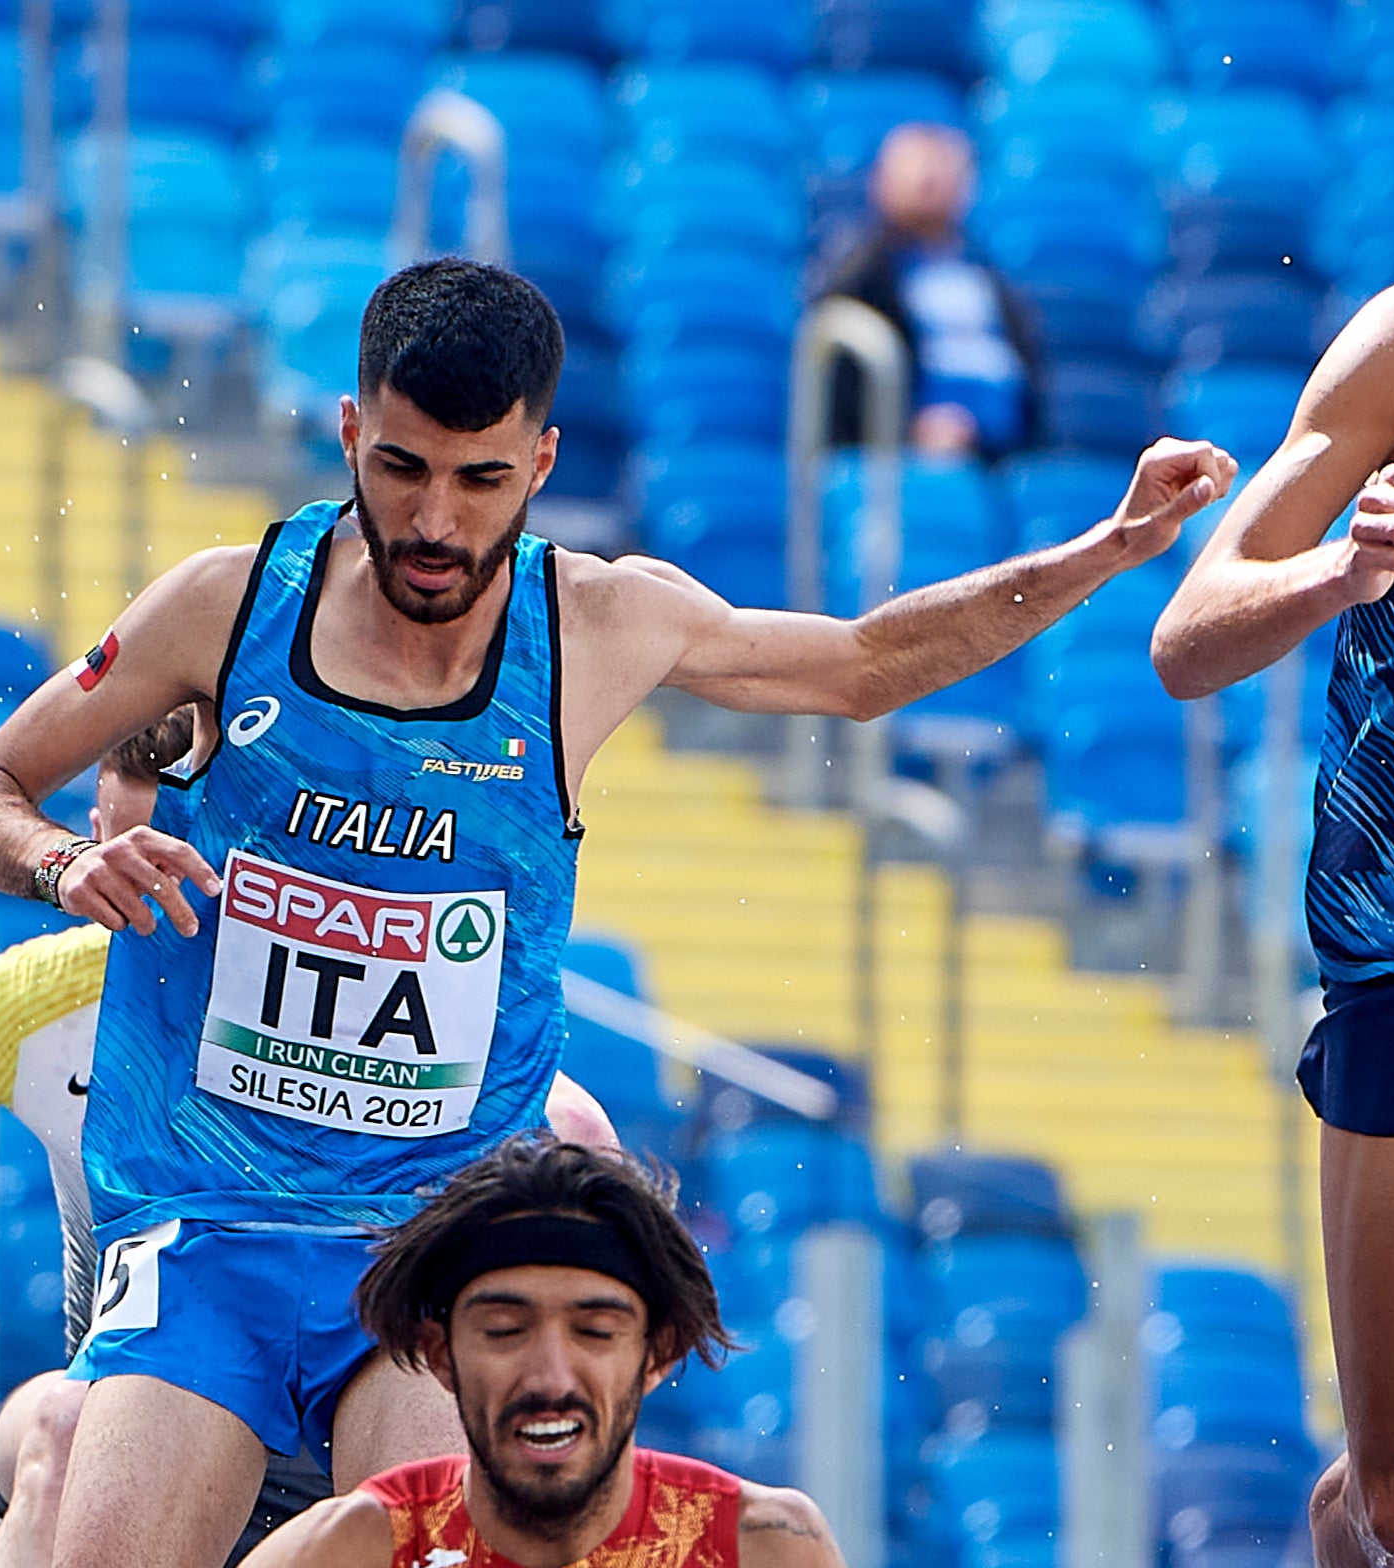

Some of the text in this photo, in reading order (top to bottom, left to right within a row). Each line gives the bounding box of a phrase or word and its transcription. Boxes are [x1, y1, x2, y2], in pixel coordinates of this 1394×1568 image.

[421, 758, 525, 782] FASTWEB
[287, 791, 454, 861] ITALIA
[232, 868, 423, 955] SPAR
[259, 941, 437, 1056] ITA
[255, 1036, 265, 1058] I
[267, 1040, 325, 1070] RUN
[229, 1064, 443, 1127] SILESIA 2021
[99, 1241, 146, 1317] 5
